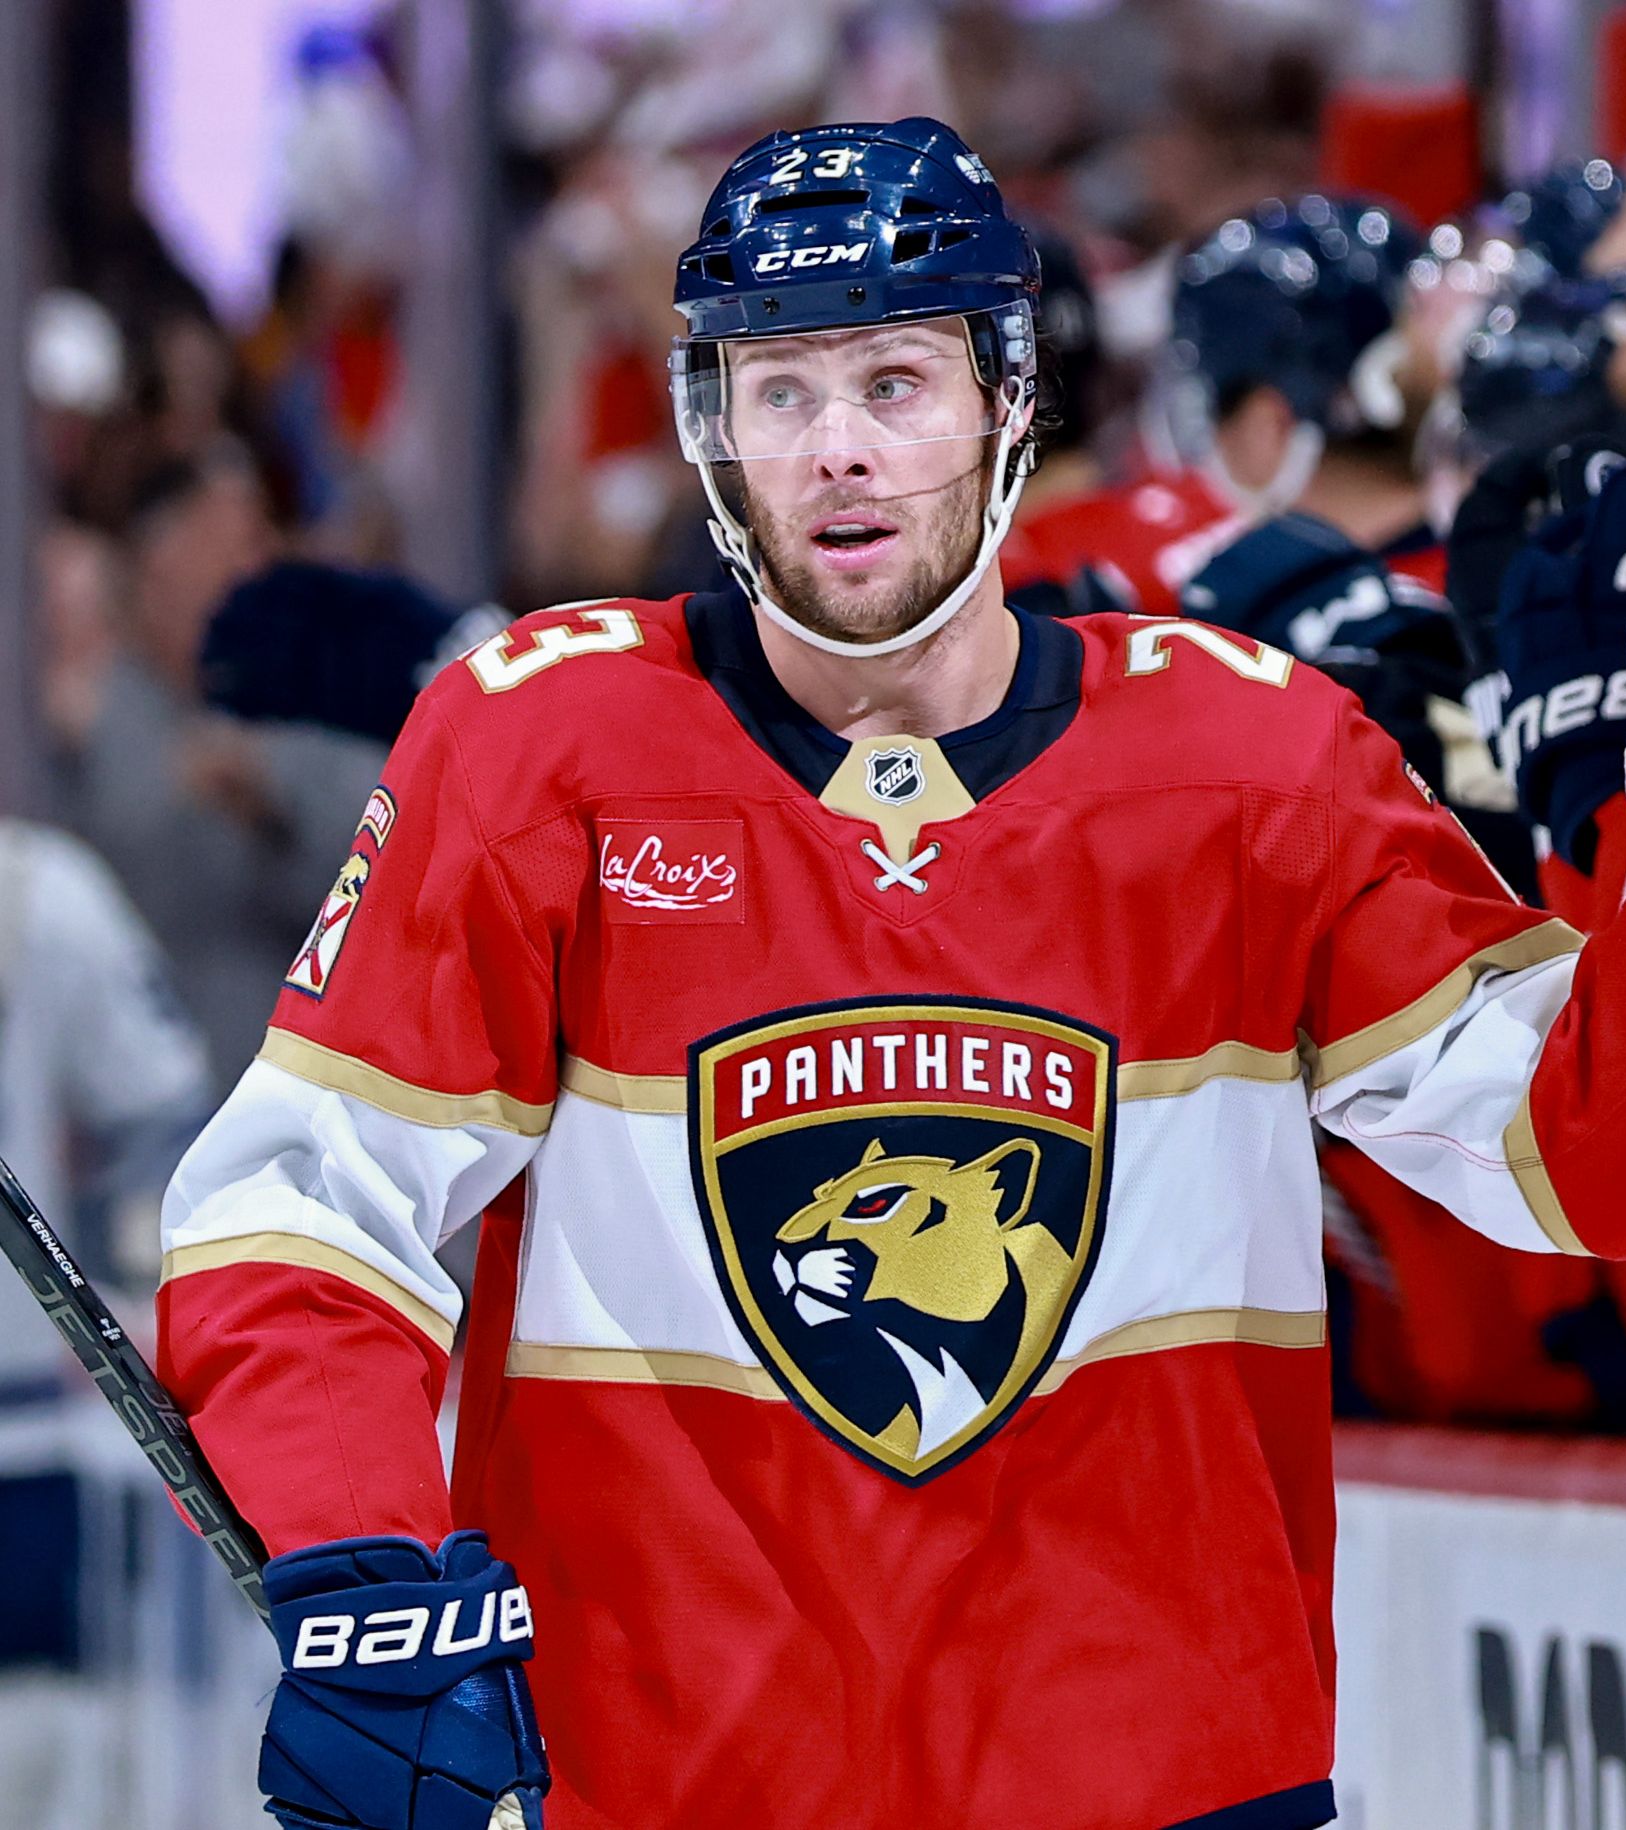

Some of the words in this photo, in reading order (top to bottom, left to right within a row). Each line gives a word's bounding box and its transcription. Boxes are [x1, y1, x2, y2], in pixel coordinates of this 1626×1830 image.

[769, 148, 853, 185] 23
[754, 242, 869, 274] CCM
[880, 762, 912, 794] NHL
[740, 1032, 1073, 1119] PANTHERS
[27, 1213, 84, 1289] VERHAEGHE
